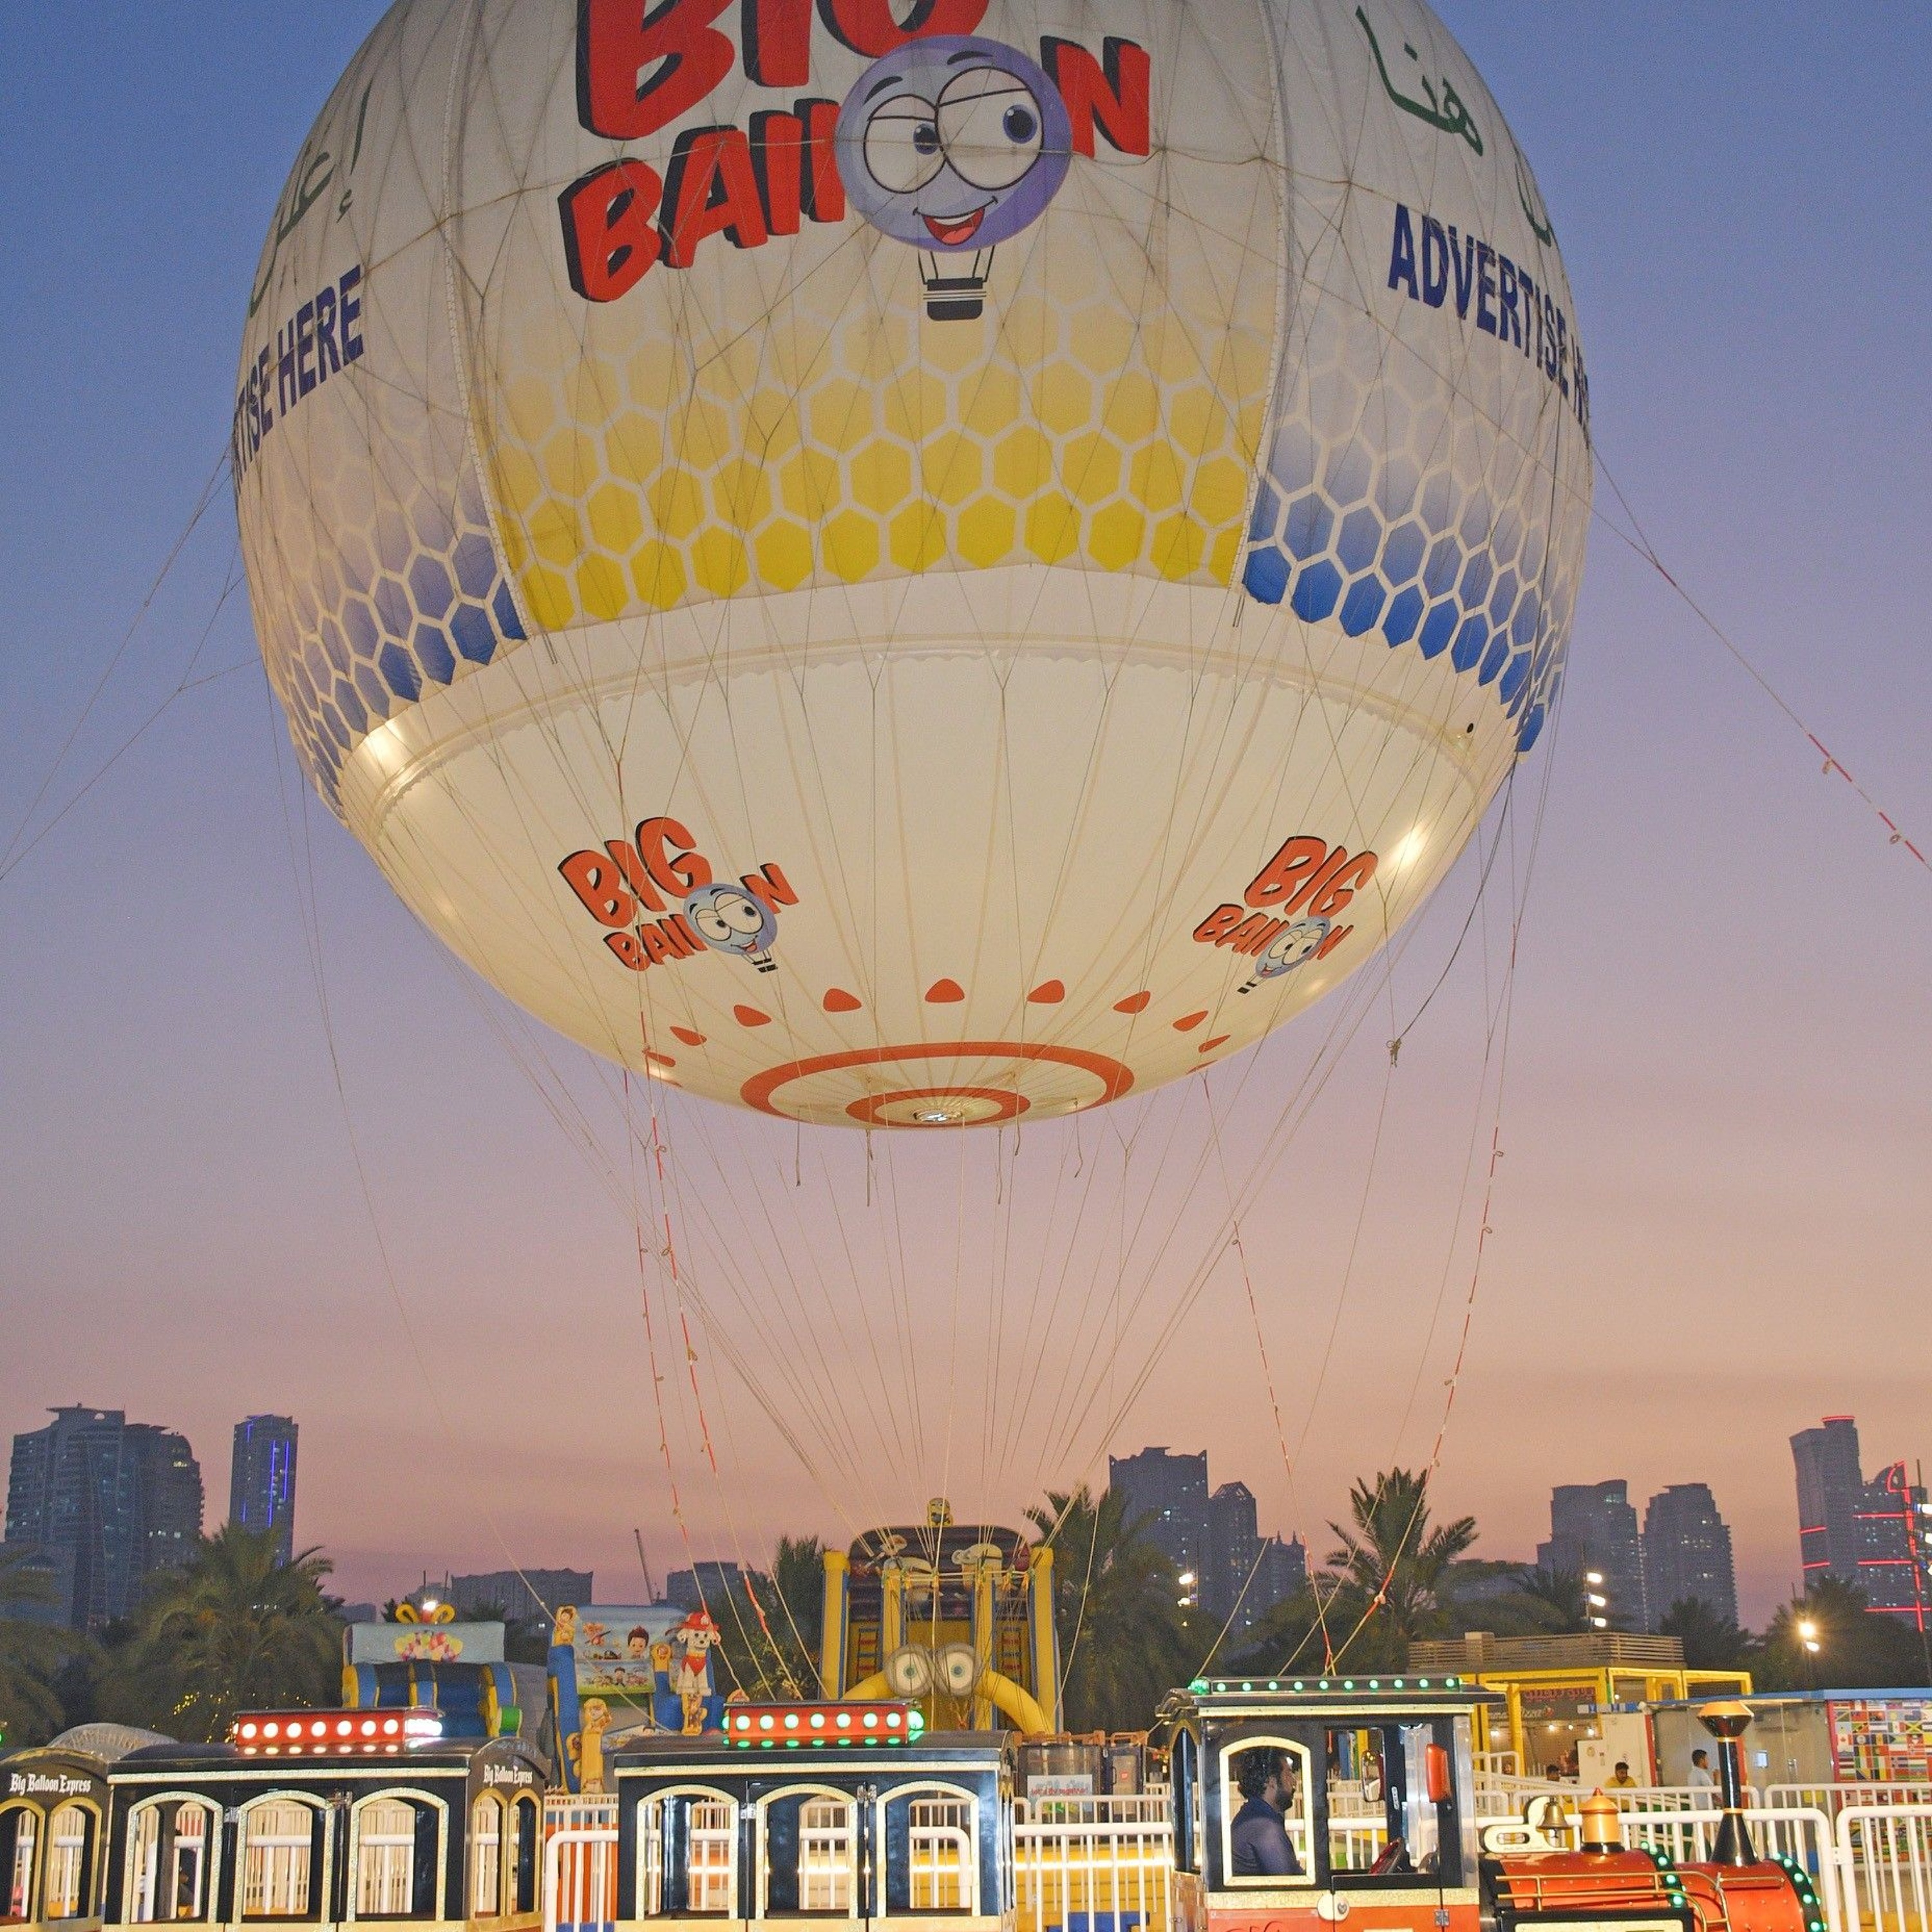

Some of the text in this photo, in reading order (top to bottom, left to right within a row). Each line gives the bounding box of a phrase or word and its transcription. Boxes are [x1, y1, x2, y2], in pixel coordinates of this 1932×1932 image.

[278, 264, 365, 417] HERE
[1388, 203, 1569, 399] ADVERTISE
[557, 817, 712, 928] BIG
[1244, 836, 1378, 917] BIG
[9, 1772, 91, 1796] Big Balloon Express
